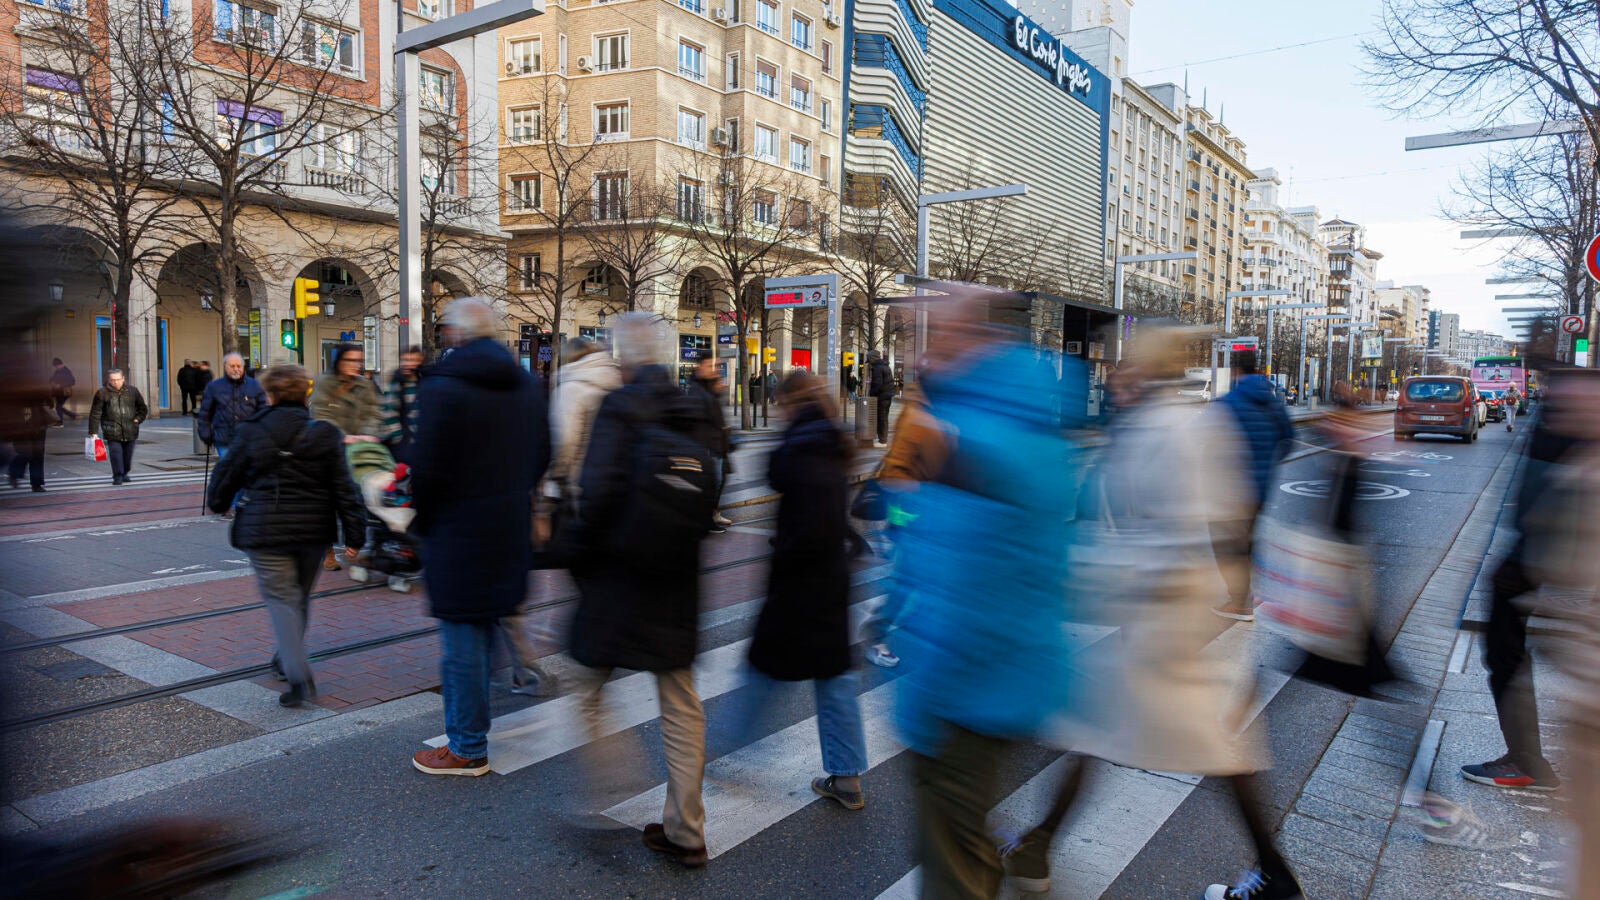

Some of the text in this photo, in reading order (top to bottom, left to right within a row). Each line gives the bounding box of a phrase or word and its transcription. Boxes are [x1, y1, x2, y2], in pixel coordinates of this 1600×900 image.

[1016, 15, 1091, 93] El Corte Inglés
